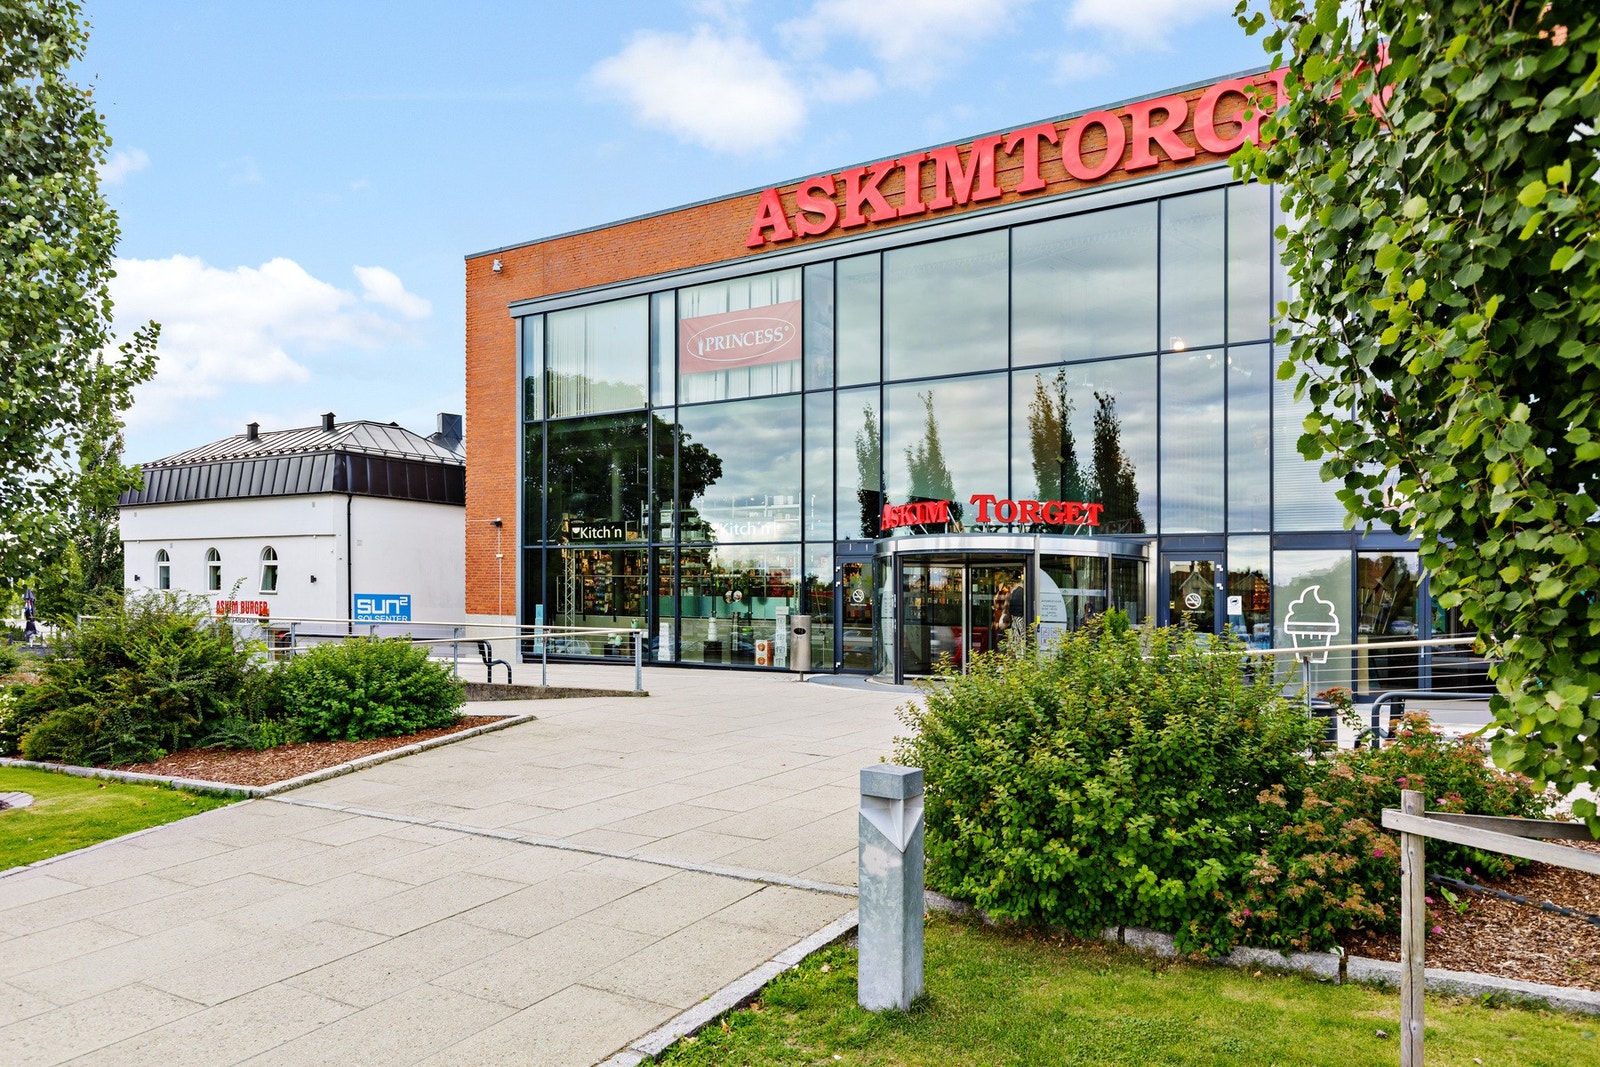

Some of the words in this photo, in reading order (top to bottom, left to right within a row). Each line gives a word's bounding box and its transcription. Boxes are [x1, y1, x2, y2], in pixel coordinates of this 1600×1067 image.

[746, 44, 1394, 249] ASKIMTORG
[705, 326, 784, 352] PRINCESS
[880, 500, 950, 530] ASKIM
[970, 494, 1104, 527] TORGET
[240, 600, 268, 615] BURGER
